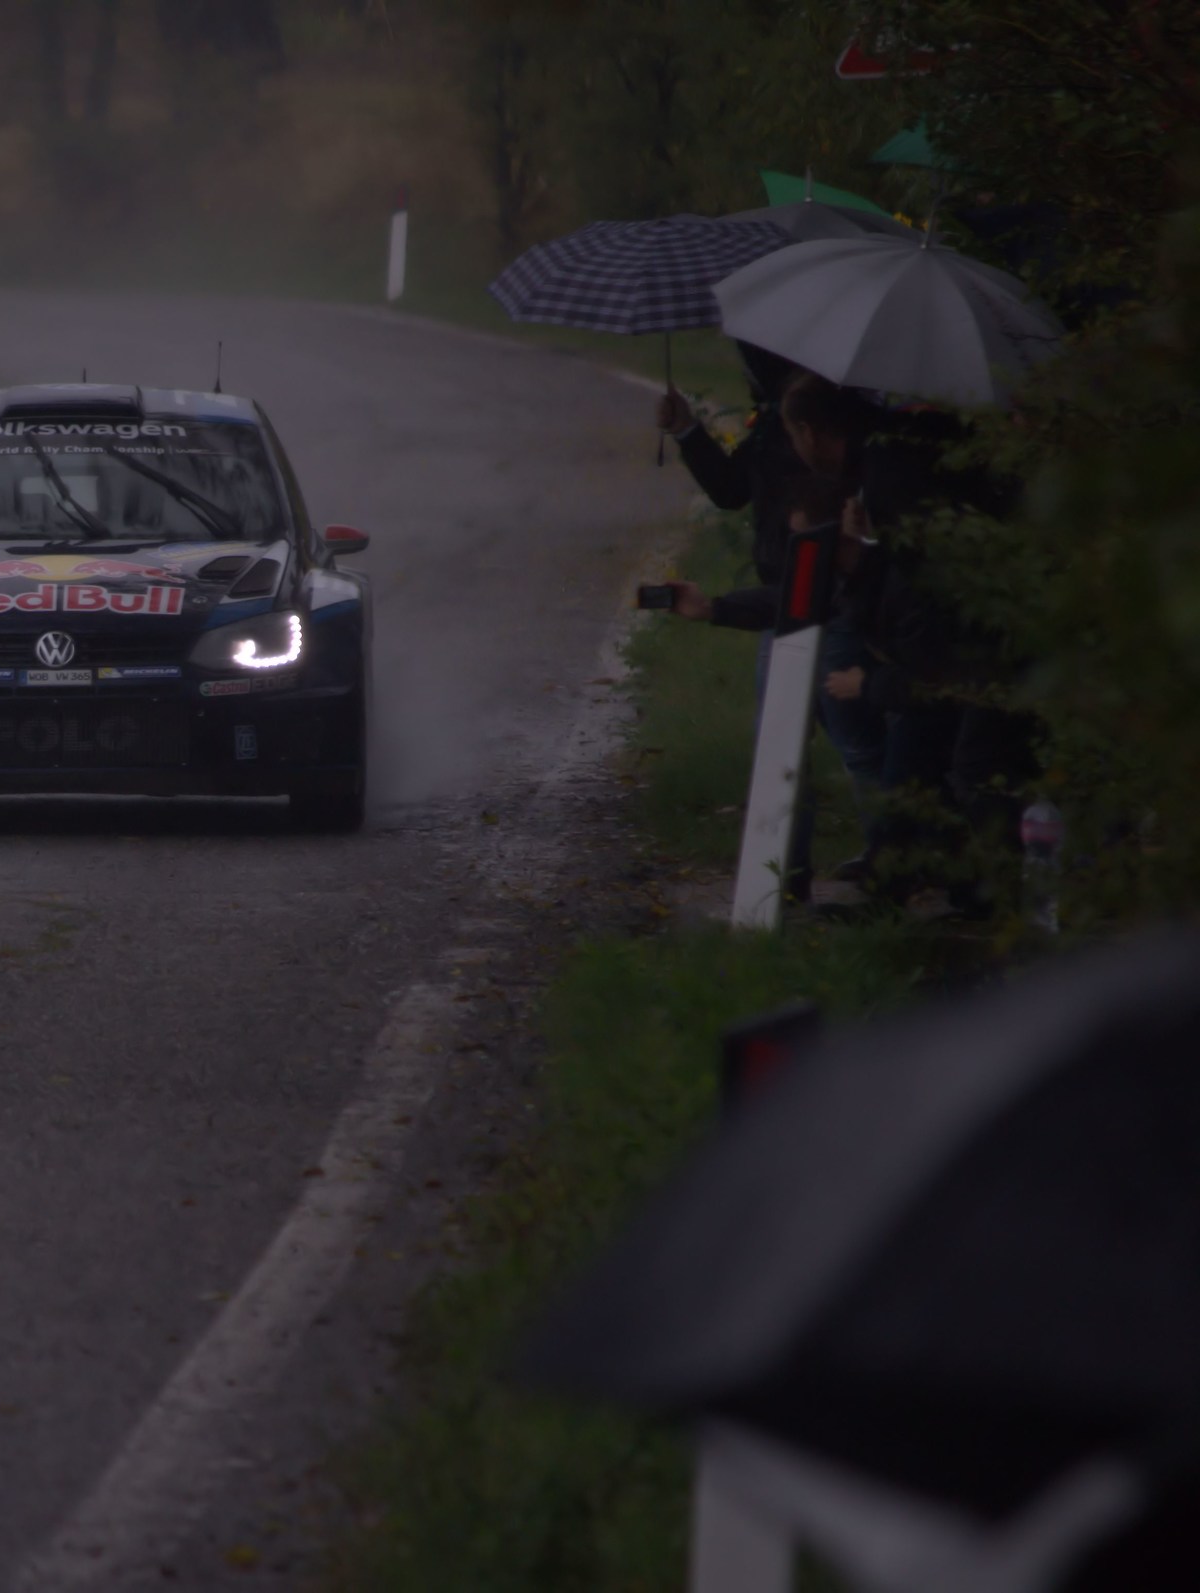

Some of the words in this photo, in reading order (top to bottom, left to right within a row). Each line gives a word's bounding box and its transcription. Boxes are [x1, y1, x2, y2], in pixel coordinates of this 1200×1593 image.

[24, 446, 60, 455] Rlly
[64, 445, 165, 455] Chamonship
[62, 584, 185, 615] Bull
[29, 672, 48, 681] WOB
[56, 672, 69, 681] VW
[70, 672, 91, 681] 365
